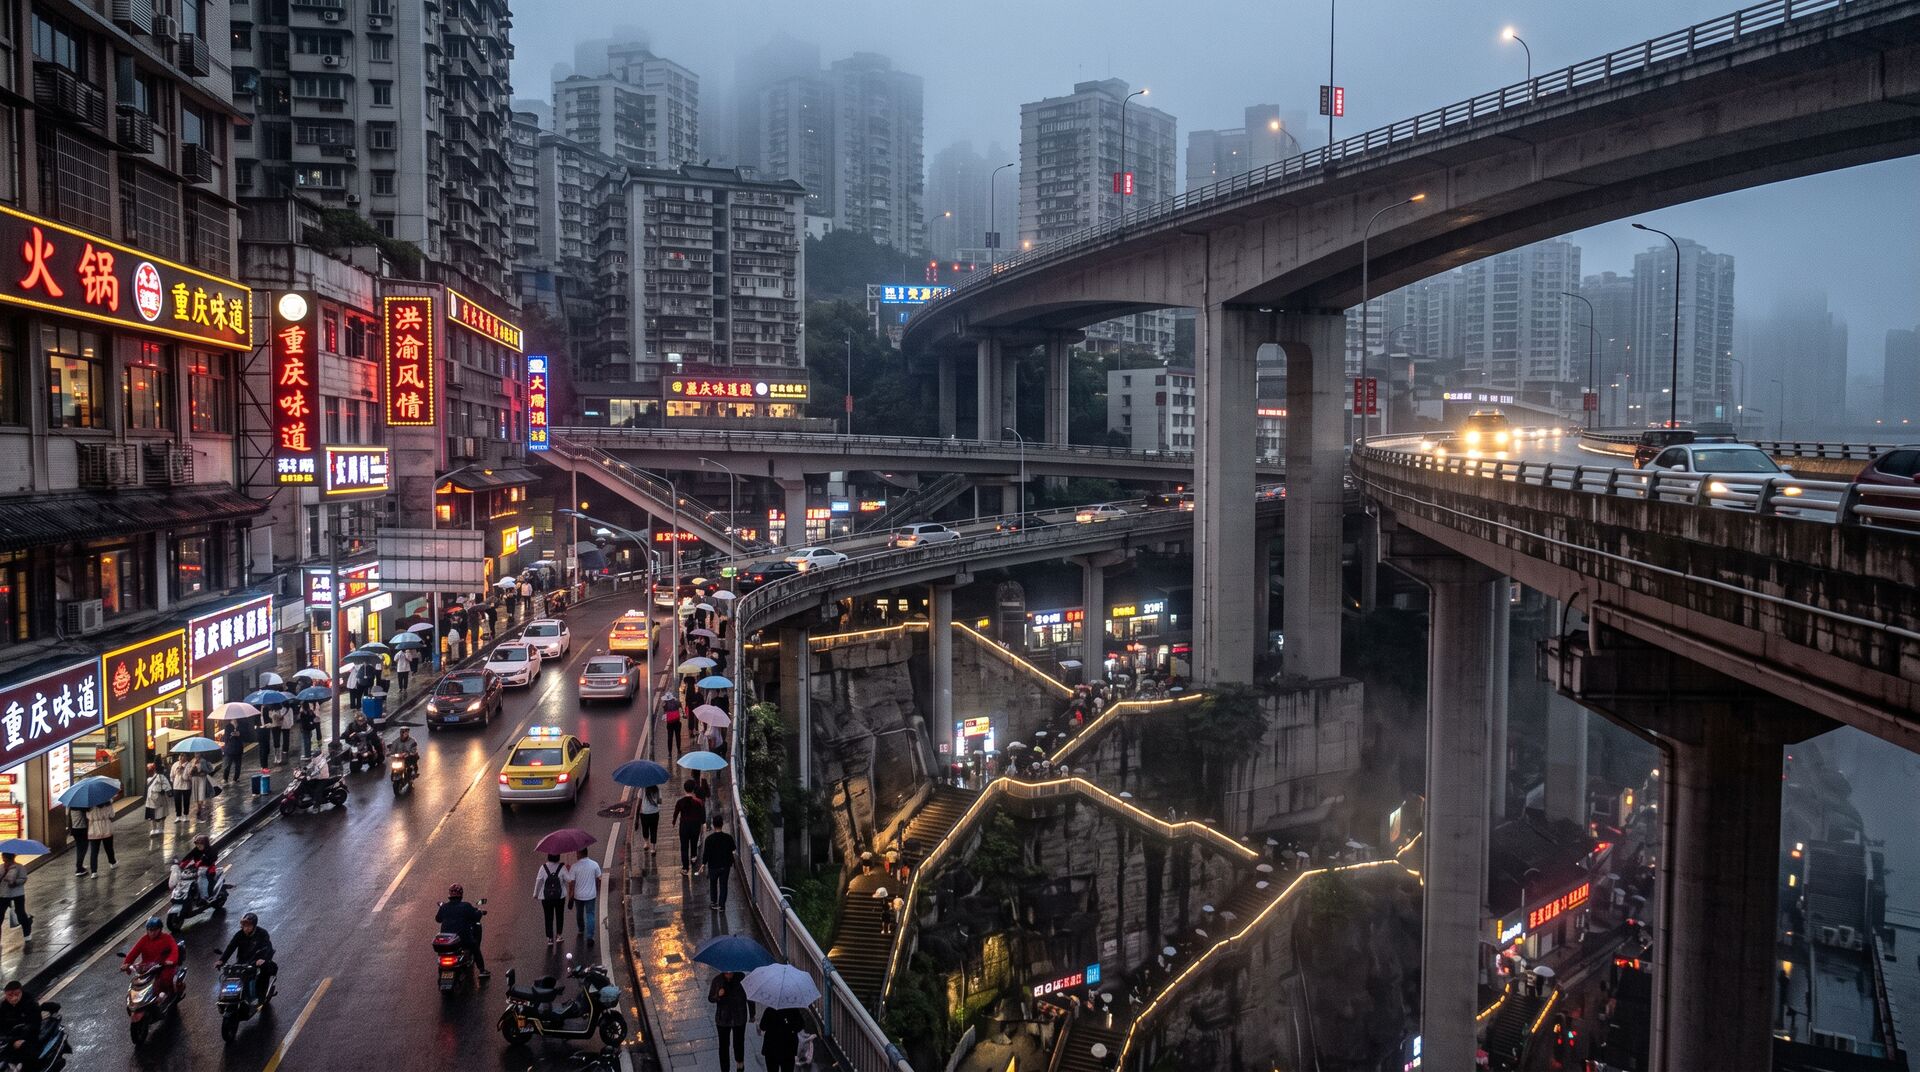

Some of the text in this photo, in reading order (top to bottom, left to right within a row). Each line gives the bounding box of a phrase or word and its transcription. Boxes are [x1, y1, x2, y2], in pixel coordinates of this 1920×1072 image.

[19, 226, 119, 312] 火锅
[171, 282, 246, 335] 重庆味道
[278, 325, 312, 452] 重庆味道
[395, 305, 425, 419] 洪渝风情
[1, 675, 99, 752] 重庆味道
